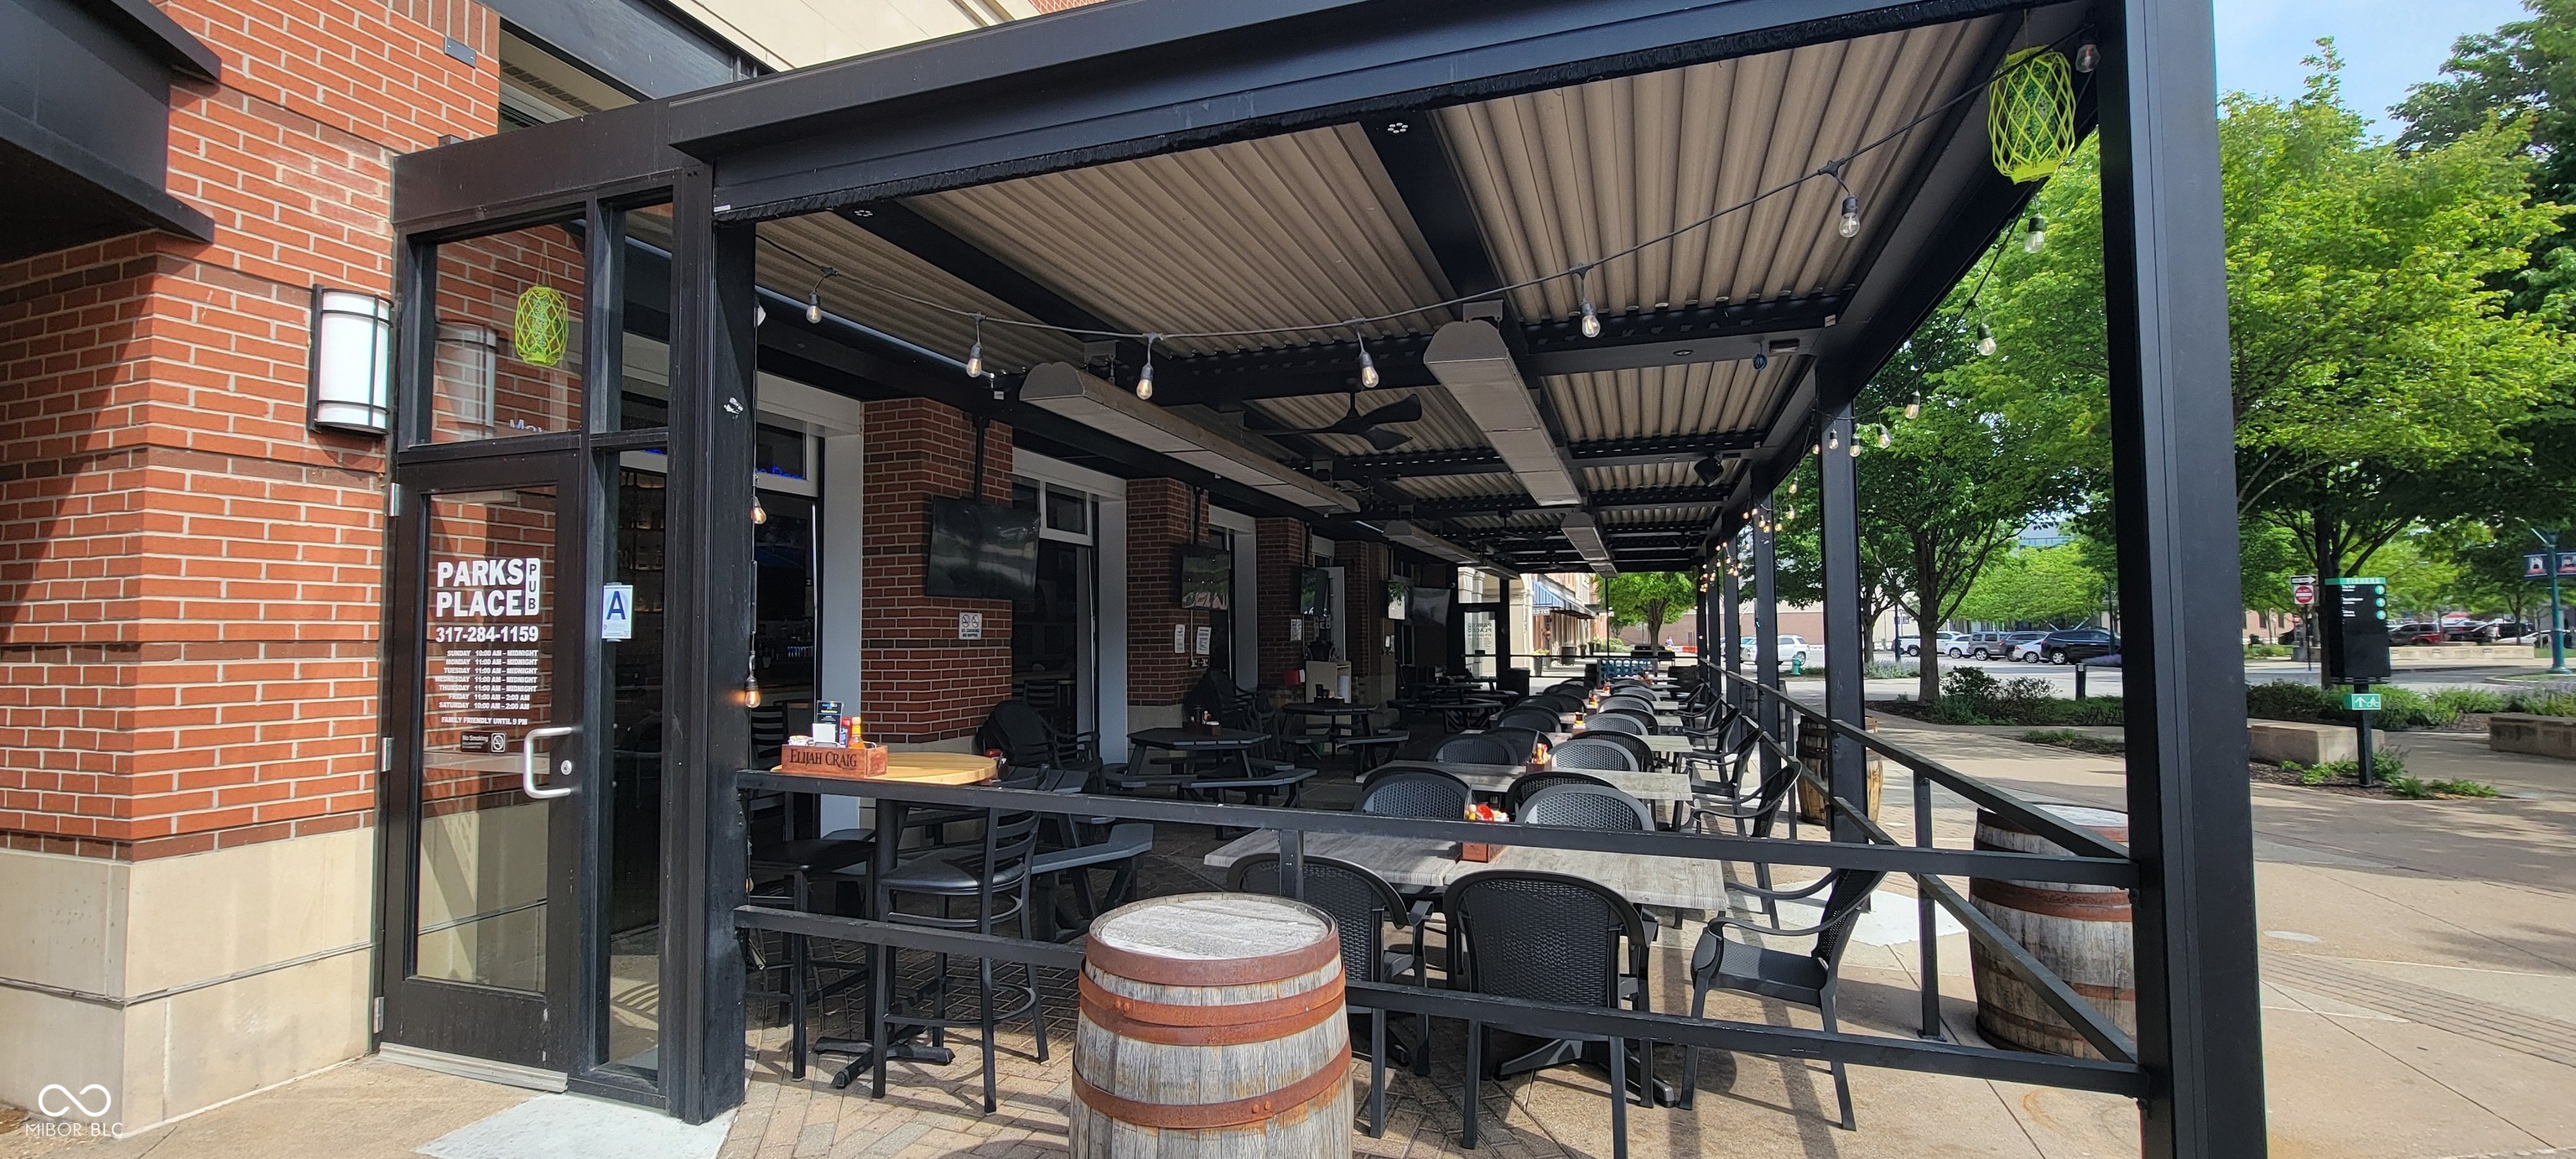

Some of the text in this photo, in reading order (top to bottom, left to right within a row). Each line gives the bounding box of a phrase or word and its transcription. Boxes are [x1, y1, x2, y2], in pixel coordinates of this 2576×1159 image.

[437, 558, 524, 587] PARKS
[527, 564, 537, 610] PUB
[436, 590, 522, 617] PLACE
[605, 590, 626, 620] A
[435, 626, 539, 642] 317-284-1159
[790, 749, 857, 767] ELIJAH CRAIG
